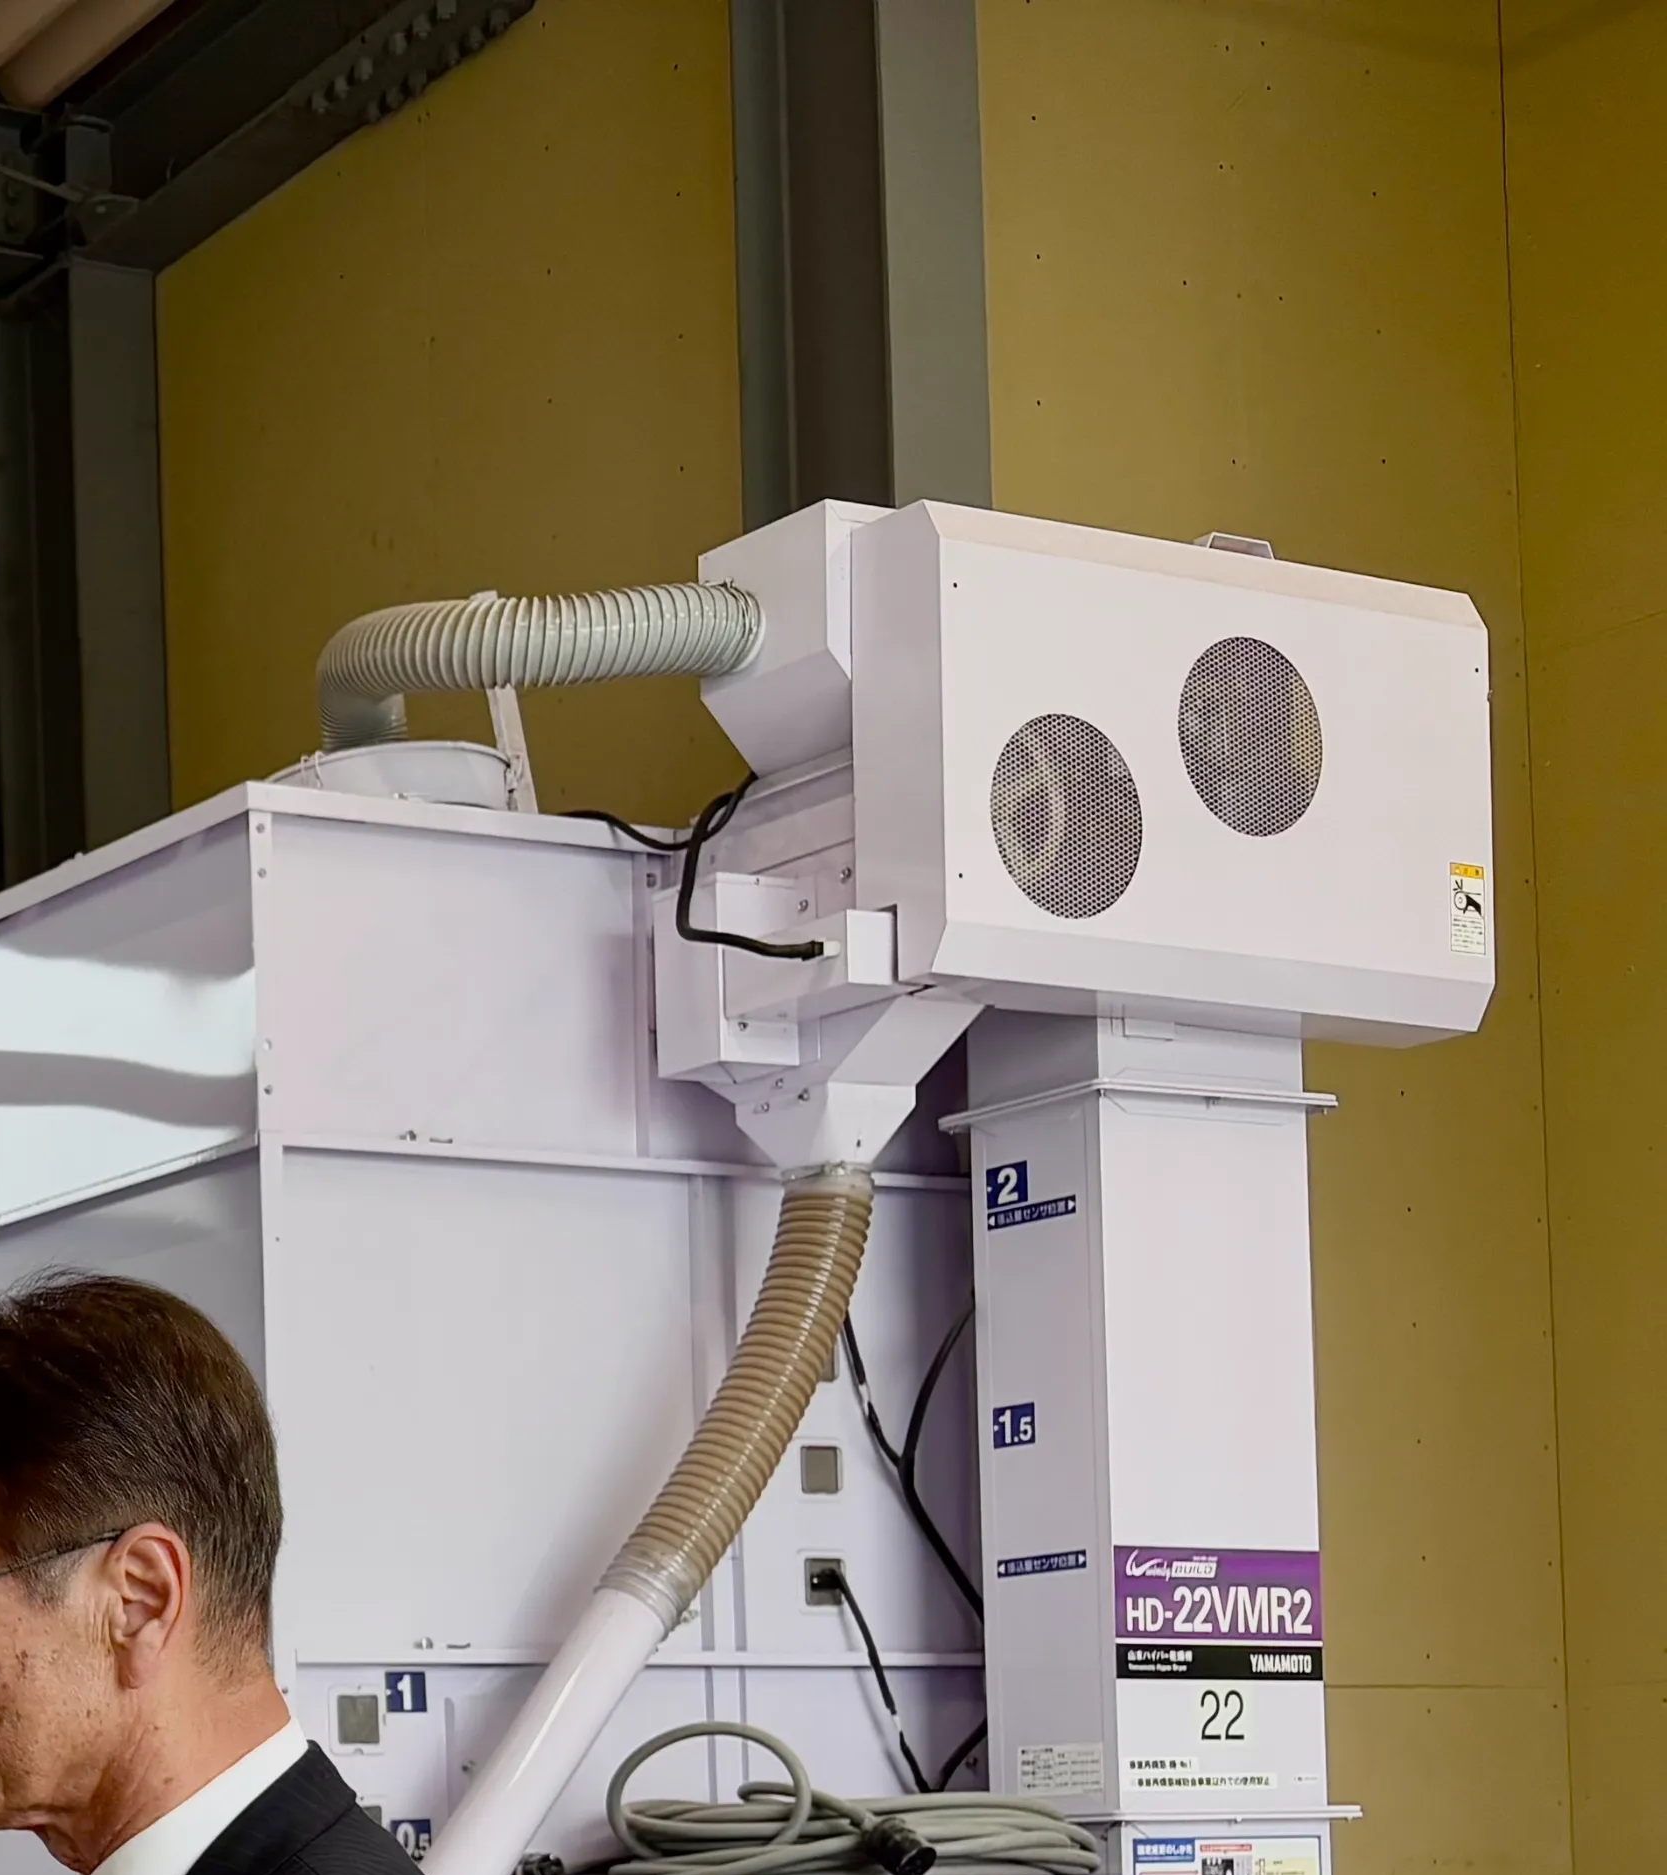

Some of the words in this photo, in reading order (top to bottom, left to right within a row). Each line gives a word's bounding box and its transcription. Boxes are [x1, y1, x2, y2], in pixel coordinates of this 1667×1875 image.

[997, 1167, 1019, 1205] 2
[998, 1409, 1033, 1444] 1.5
[1126, 1584, 1313, 1635] HD-22VMR2
[1249, 1654, 1313, 1674] YAMAMOTO
[397, 1673, 412, 1711] 1
[1200, 1689, 1245, 1740] 22
